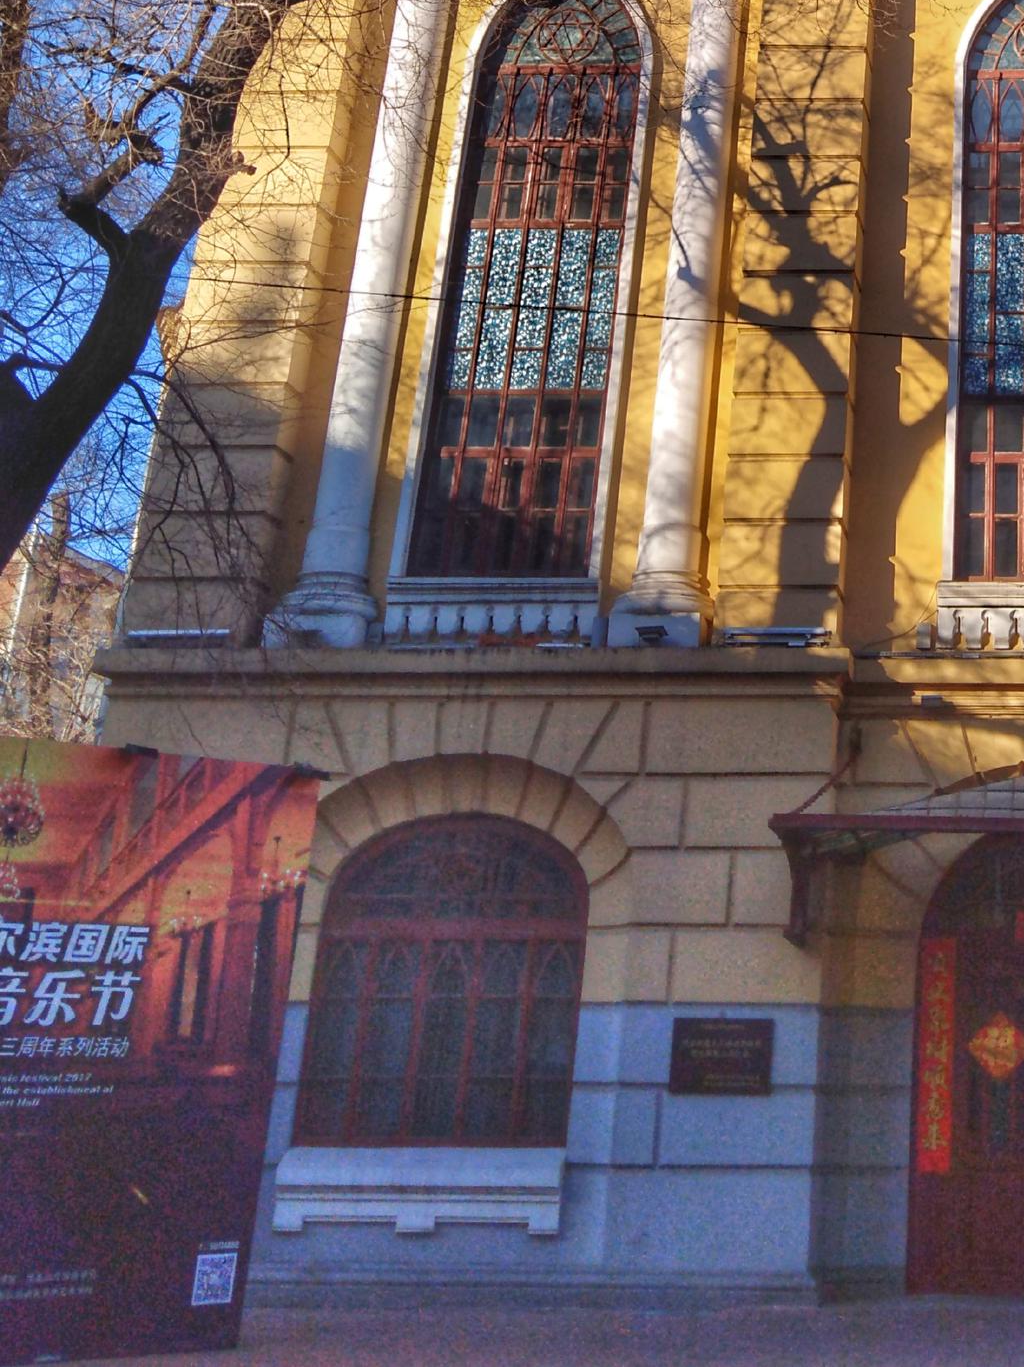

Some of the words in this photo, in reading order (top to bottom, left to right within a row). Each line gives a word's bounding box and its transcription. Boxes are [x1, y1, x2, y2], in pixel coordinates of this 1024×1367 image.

[0, 1036, 129, 1057] 三周年系列活动
